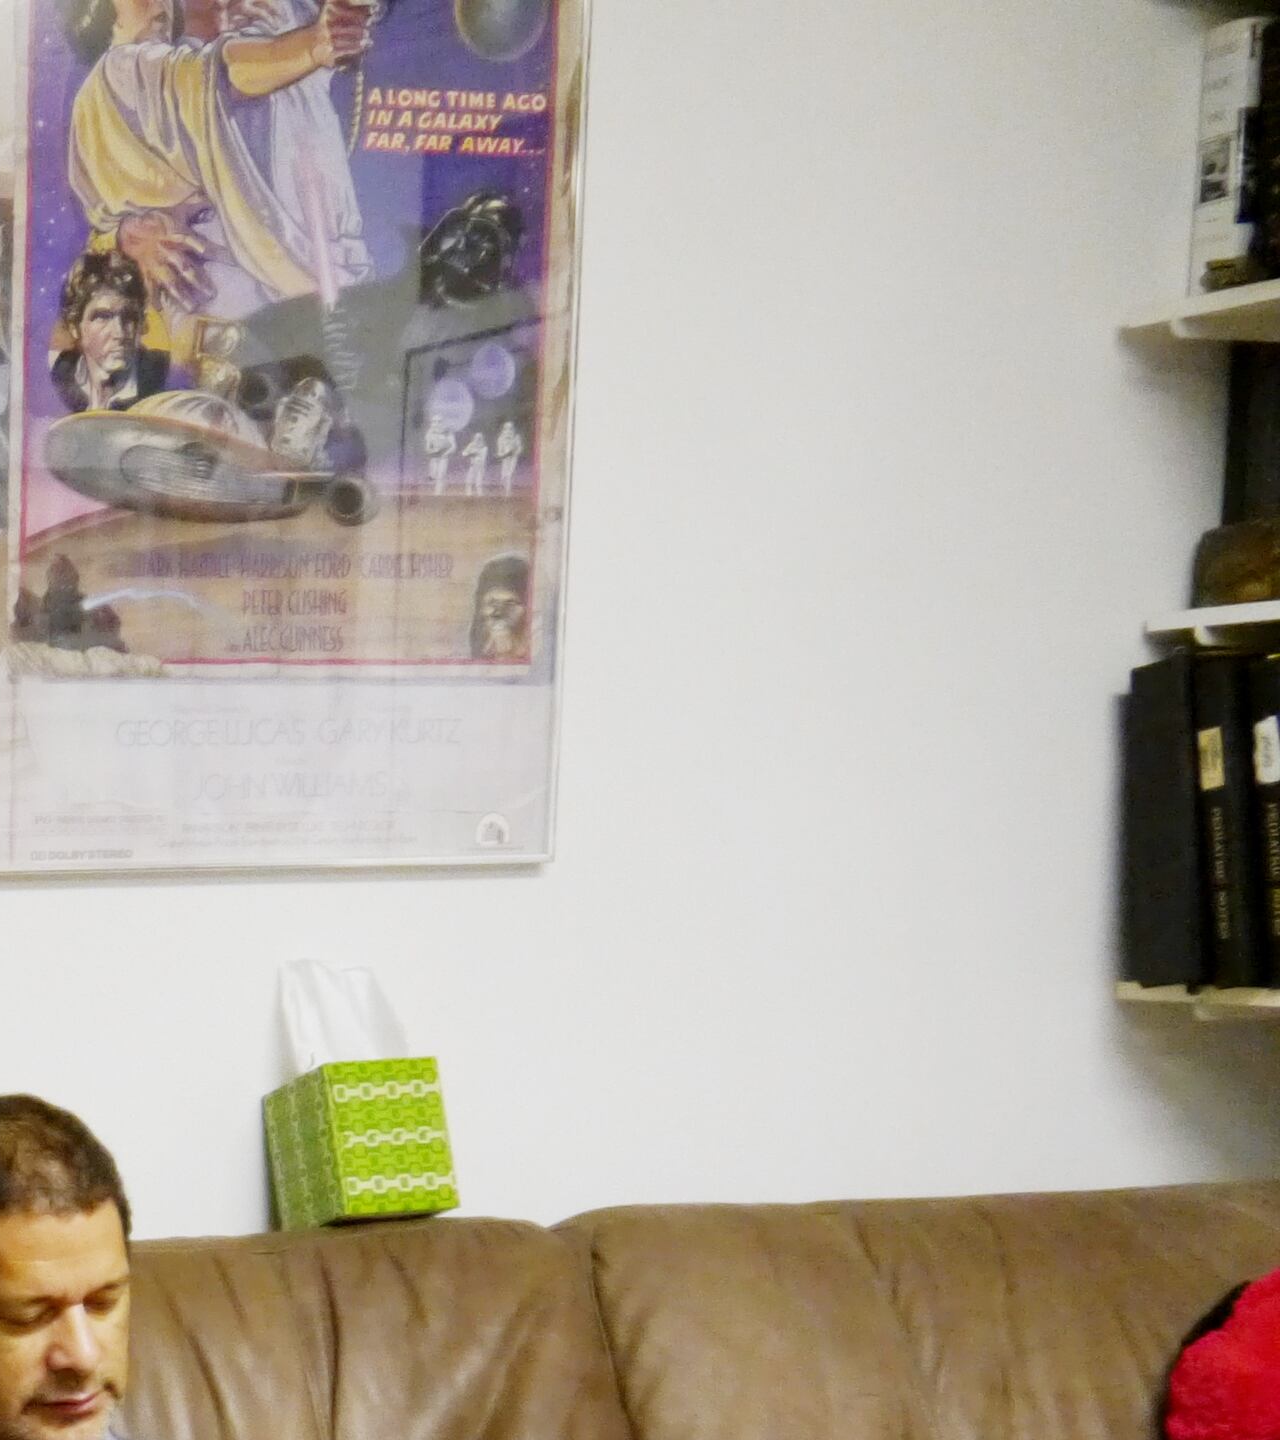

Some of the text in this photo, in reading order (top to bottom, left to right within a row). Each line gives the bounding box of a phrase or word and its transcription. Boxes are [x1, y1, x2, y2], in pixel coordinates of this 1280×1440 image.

[368, 87, 547, 112] A LONG TIME AGO
[368, 110, 503, 130] IN A GALAXY
[366, 132, 410, 152] FAR,
[415, 133, 453, 150] FAR
[288, 588, 347, 616] CUSHING
[242, 624, 277, 651] ALEC
[116, 717, 463, 746] GEORGE LUCAS GARY KURTZ
[192, 769, 389, 801] JOHN WILLIAMS
